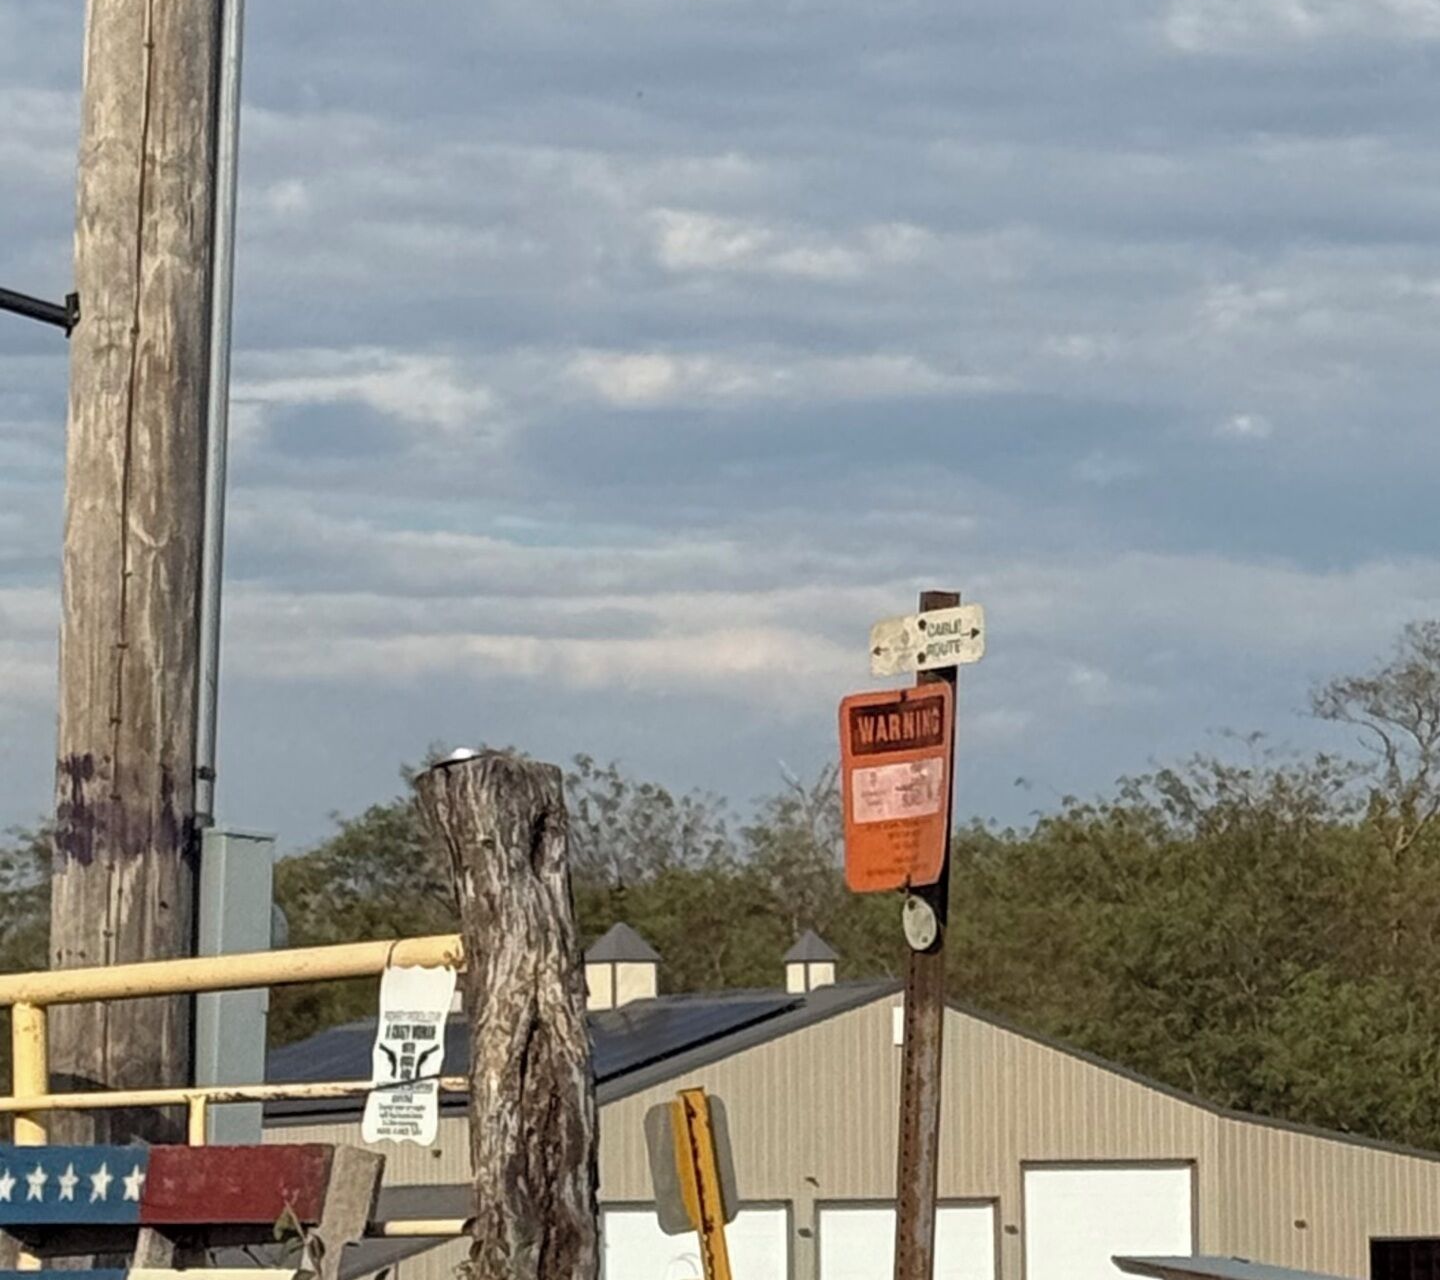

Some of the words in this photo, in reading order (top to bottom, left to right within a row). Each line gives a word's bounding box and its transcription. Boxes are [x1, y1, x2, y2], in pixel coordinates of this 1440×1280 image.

[927, 618, 962, 637] CABLE
[926, 638, 960, 657] ROUTE
[857, 706, 940, 744] WARNING
